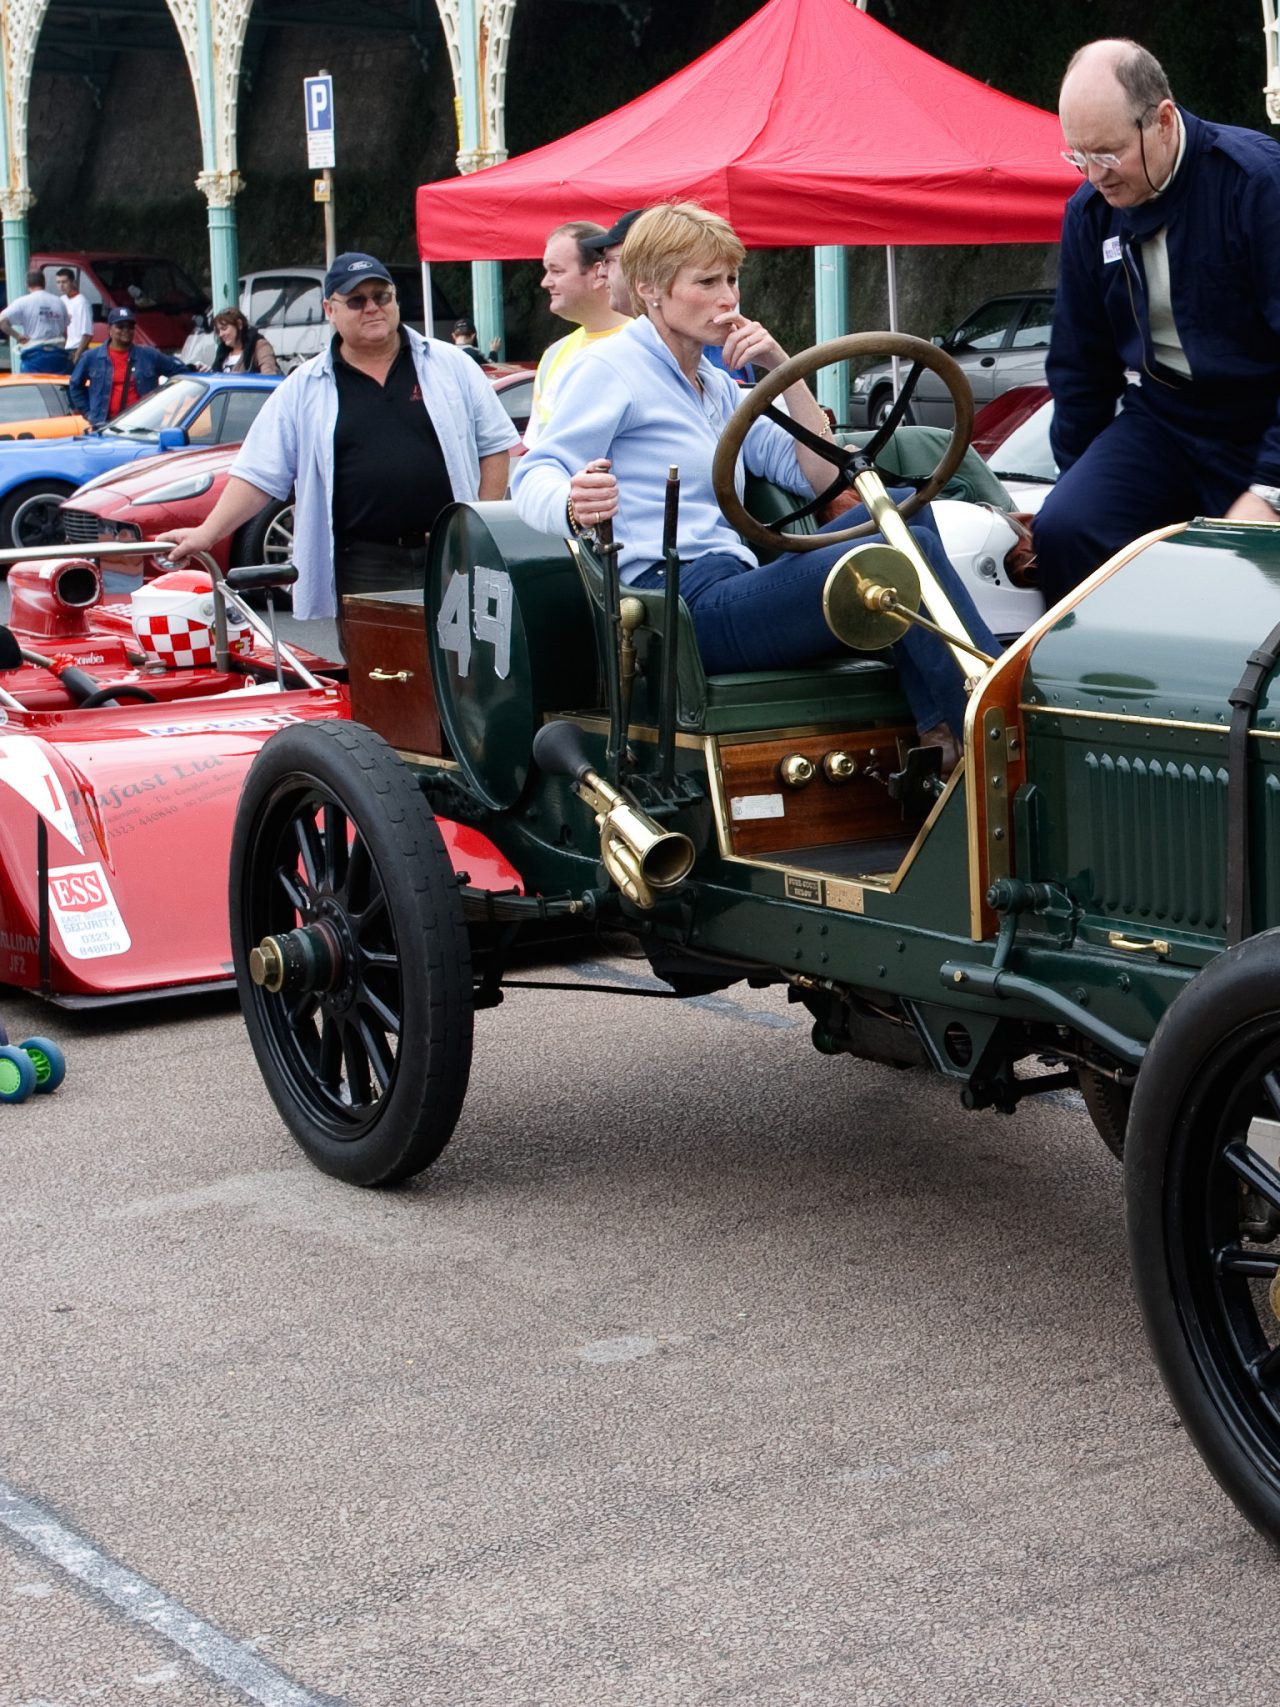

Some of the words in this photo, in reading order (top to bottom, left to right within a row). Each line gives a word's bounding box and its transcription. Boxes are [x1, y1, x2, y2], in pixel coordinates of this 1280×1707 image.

[310, 83, 328, 129] P
[436, 565, 514, 680] 49
[51, 874, 104, 907] ESS
[63, 916, 117, 934] SECURITY
